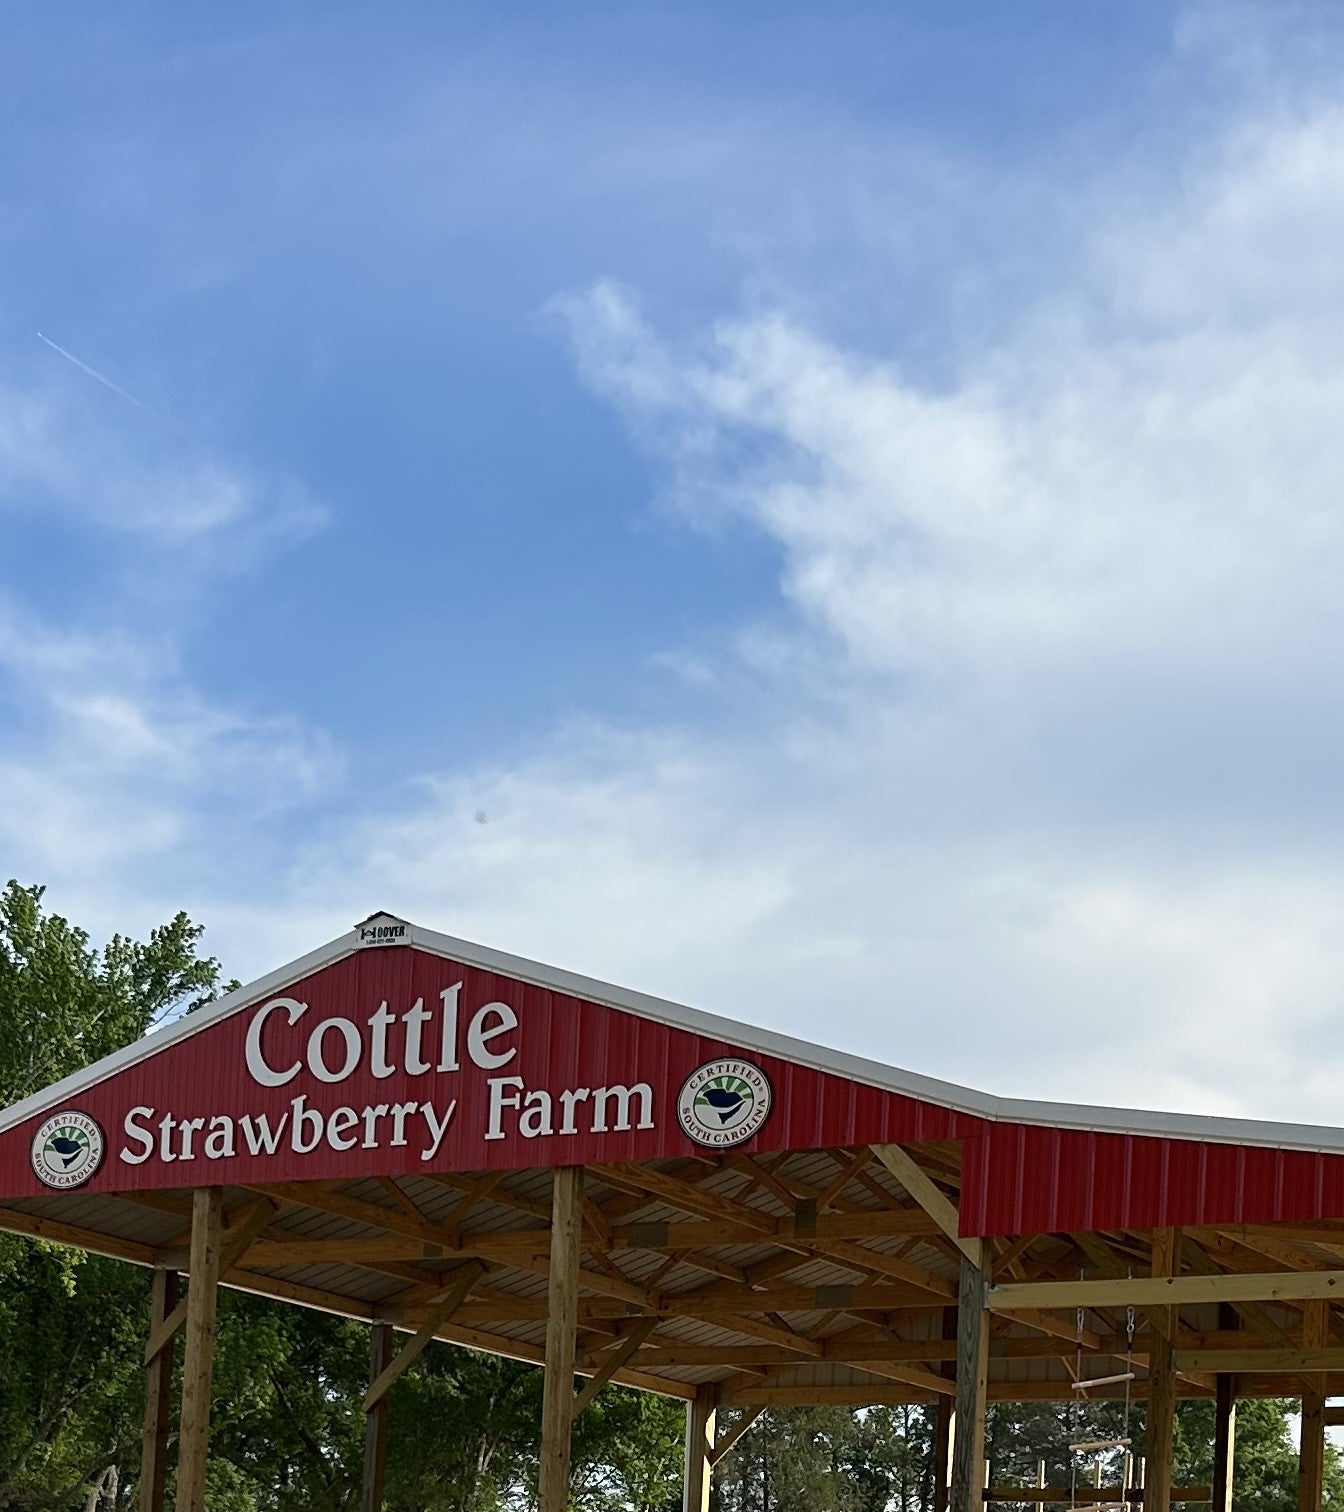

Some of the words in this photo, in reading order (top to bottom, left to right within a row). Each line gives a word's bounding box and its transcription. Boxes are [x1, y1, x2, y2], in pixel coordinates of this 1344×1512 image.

[245, 981, 517, 1087] Cottle
[690, 1064, 761, 1089] CERTIFIED
[41, 1116, 96, 1137] CERTIFIED
[119, 1095, 456, 1164] Strawberry
[484, 1076, 654, 1140] Farm
[682, 1107, 711, 1141] SOUTH
[713, 1098, 765, 1142] CAROLINA
[35, 1153, 56, 1183] SOUTH
[58, 1148, 99, 1184] CAROLINA
